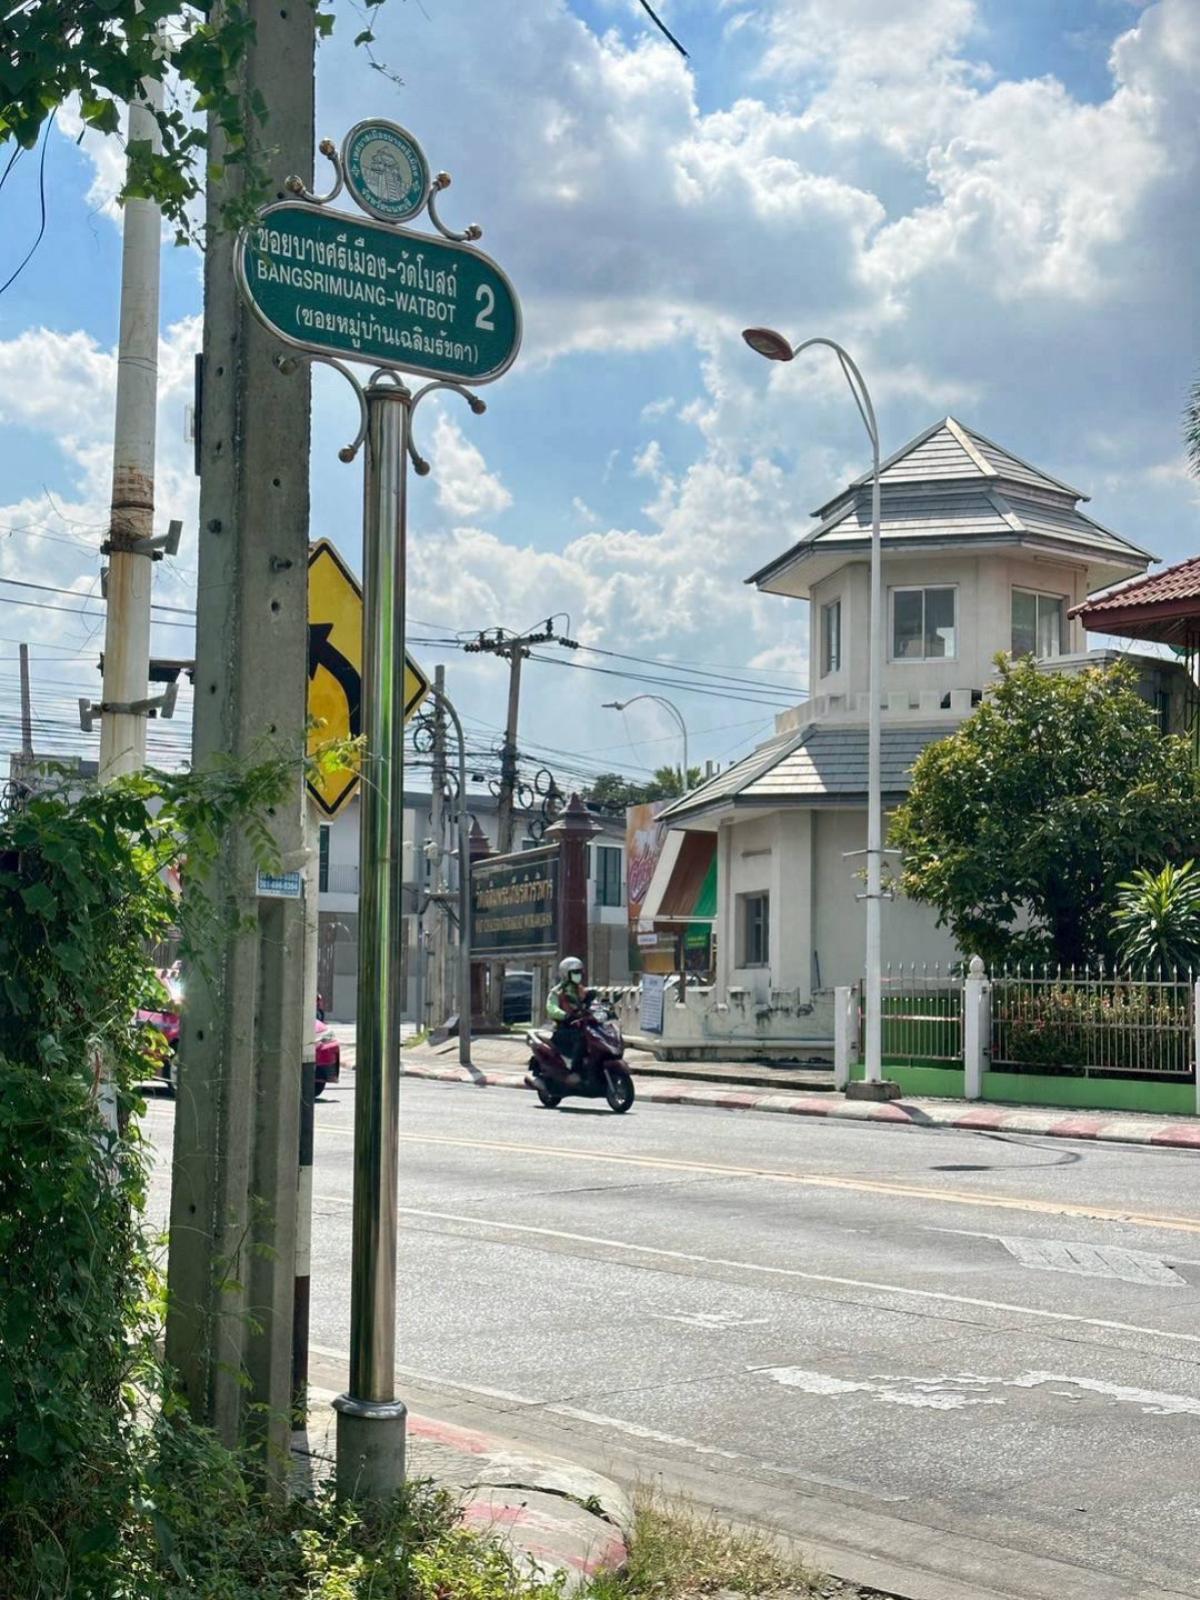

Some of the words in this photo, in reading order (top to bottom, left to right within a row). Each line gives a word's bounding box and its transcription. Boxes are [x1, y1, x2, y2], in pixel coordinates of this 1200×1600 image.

[257, 227, 457, 298] ซอยบางศรีเมือง-วัดโบสถ์
[257, 259, 456, 323] BANGSRIMUANG-WATBOT
[475, 284, 495, 331] 2
